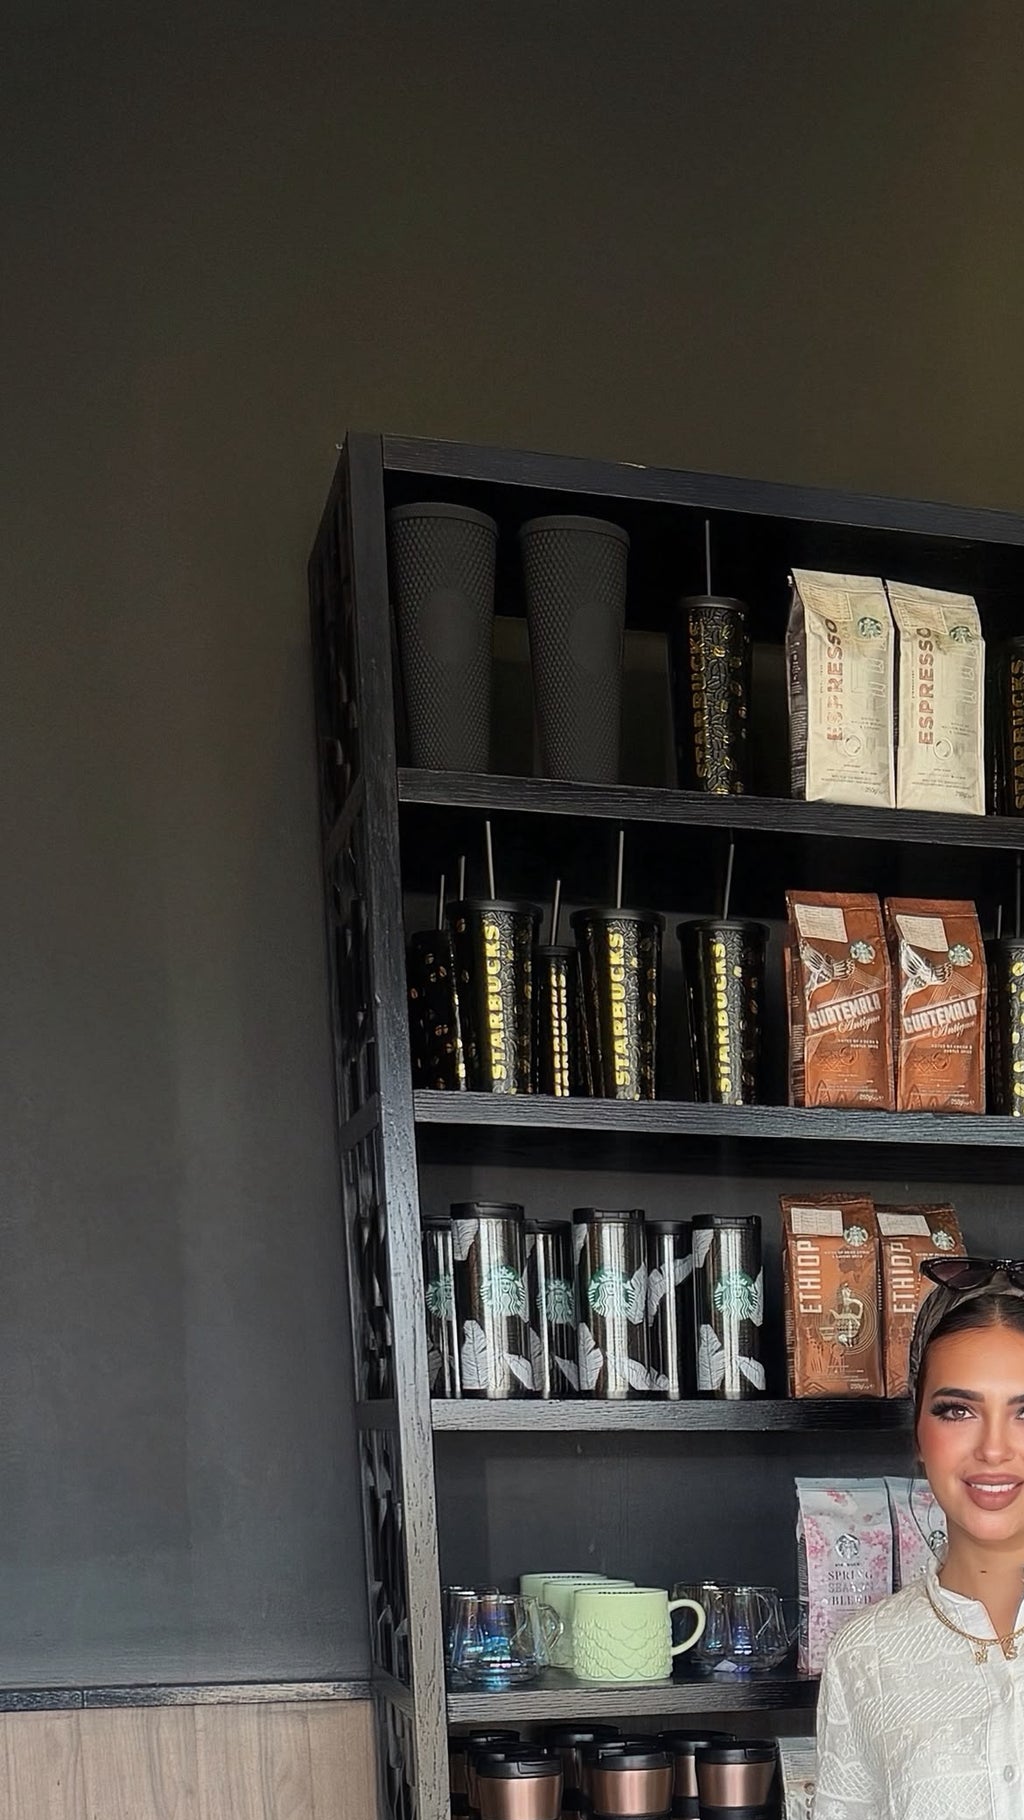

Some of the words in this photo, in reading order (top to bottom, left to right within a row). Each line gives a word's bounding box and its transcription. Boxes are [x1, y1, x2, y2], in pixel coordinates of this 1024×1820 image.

[824, 618, 843, 741] ESPRESSO
[916, 627, 934, 745] ESPRESSO
[484, 924, 507, 1081] STARBUCKS
[609, 932, 631, 1086] STARBUCKS
[808, 992, 882, 1030] GUATEMALA
[903, 998, 978, 1034] GUATEMALA
[796, 1235, 822, 1314] ETHIOPI
[889, 1237, 916, 1314] ETHIOPI
